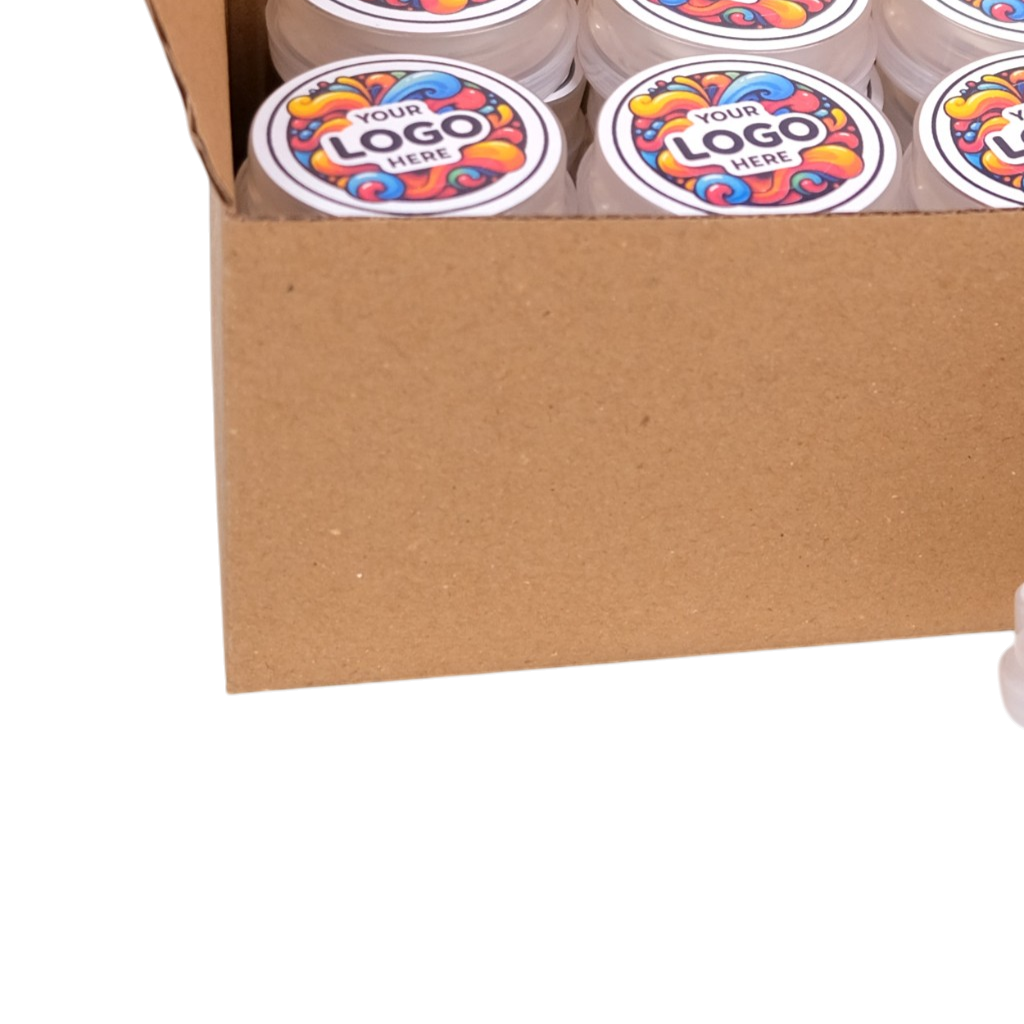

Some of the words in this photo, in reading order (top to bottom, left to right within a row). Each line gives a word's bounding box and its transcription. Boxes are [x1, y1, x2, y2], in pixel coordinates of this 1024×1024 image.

[355, 104, 423, 124] YOUR
[694, 106, 760, 125] YOUR
[329, 112, 483, 159] LOGO
[673, 117, 819, 161] LOGO
[387, 147, 452, 169] HERE
[729, 151, 793, 171] HERE
